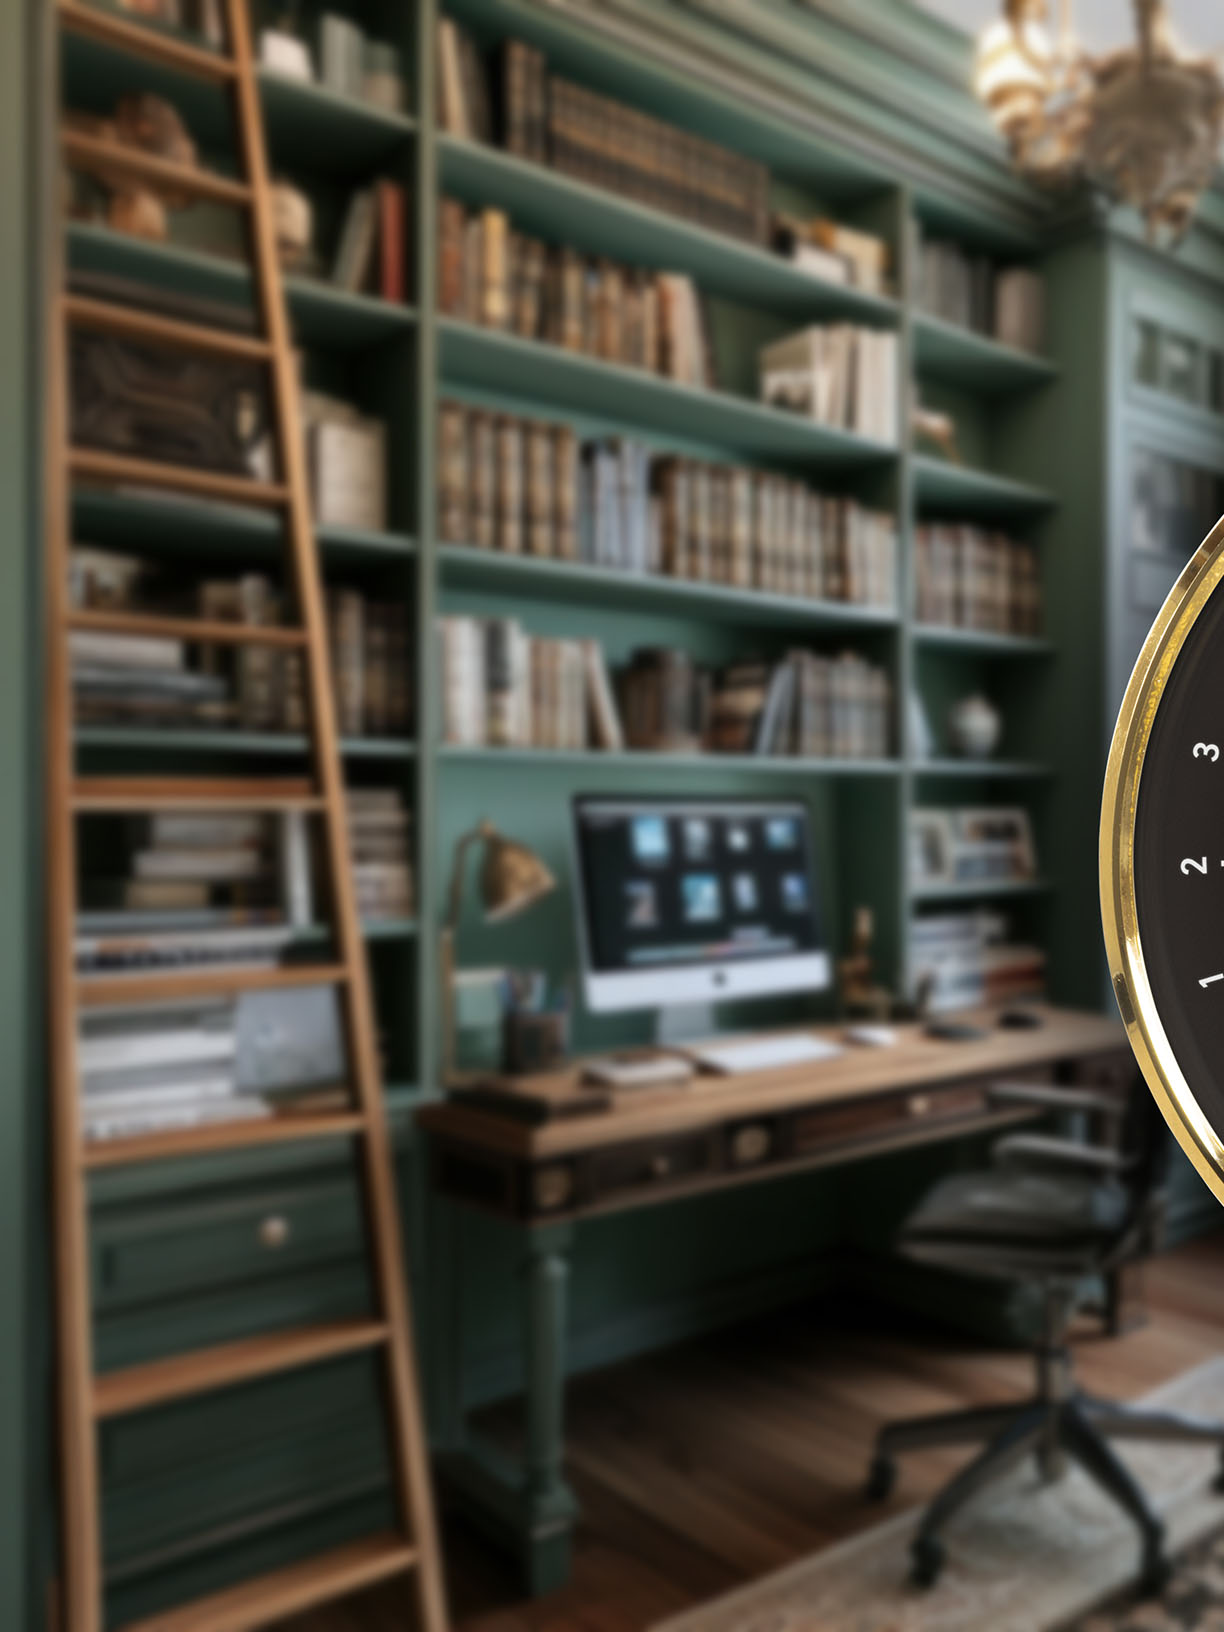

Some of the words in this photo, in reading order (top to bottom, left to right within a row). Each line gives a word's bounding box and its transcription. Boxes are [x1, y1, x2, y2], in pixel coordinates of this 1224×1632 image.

[1193, 743, 1219, 762] 3
[1180, 857, 1207, 875] 2
[1199, 973, 1224, 988] 1
